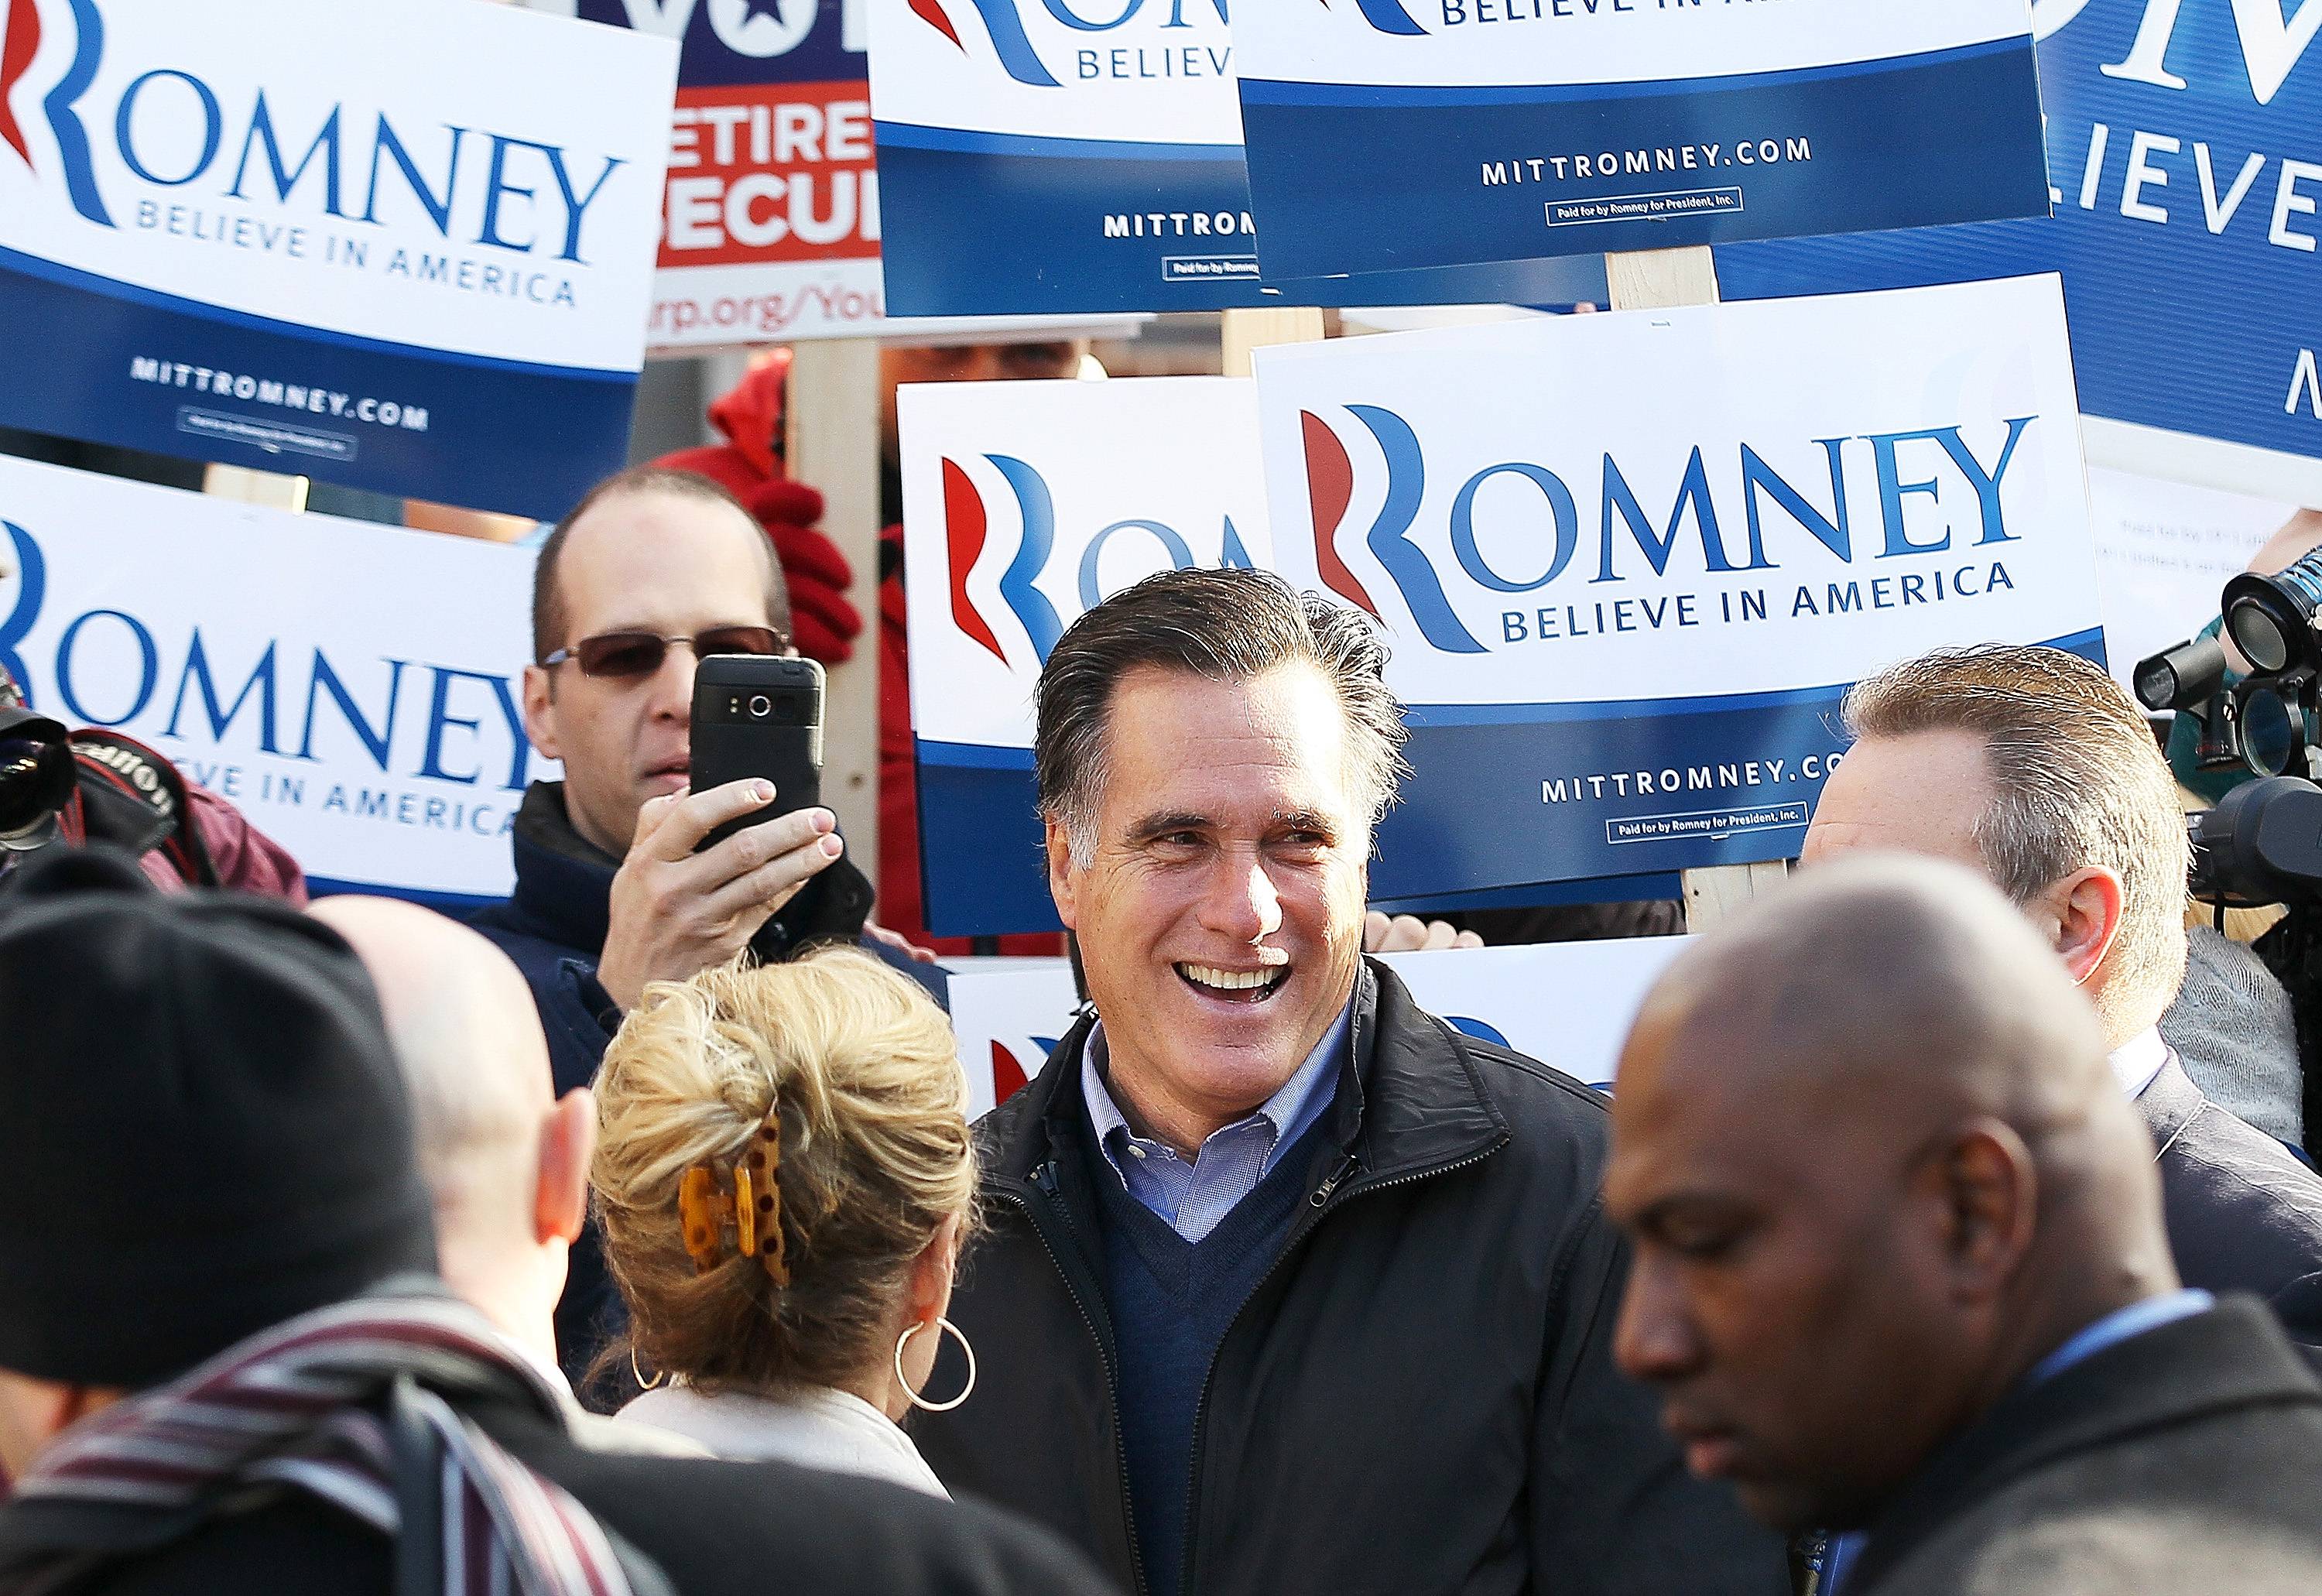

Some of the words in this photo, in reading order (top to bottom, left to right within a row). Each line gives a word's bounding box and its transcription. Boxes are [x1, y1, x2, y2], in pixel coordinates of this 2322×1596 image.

[1077, 46, 1233, 79] BELIEV
[0, 0, 630, 266] ROMNEY
[668, 100, 874, 168] ETIRE
[1481, 136, 1812, 187] MITTROMNEY.COM
[1557, 204, 1579, 218] Paid
[1581, 204, 1595, 216] for
[1597, 203, 1609, 216] by
[1610, 202, 1649, 214] Romney
[1649, 200, 1665, 211] for
[2050, 122, 2322, 252] IEVE
[135, 198, 307, 259] BELIEVE
[325, 235, 369, 269] IN
[387, 247, 577, 308] AMERICA
[129, 355, 430, 432] MITTROMNEY.COM
[1300, 403, 2039, 654] ROMNEY
[1502, 594, 1700, 643] BELIEVE
[1721, 588, 1766, 623] IN
[1791, 560, 2015, 618] AMERICA
[262, 773, 306, 807] IN
[1618, 823, 1641, 836] Paid
[1642, 823, 1657, 834] for
[1658, 821, 1671, 834] by
[1672, 820, 1711, 832] Romney
[1713, 816, 1728, 827] for
[1728, 811, 1779, 826] President,
[1779, 810, 1799, 821] Inc.
